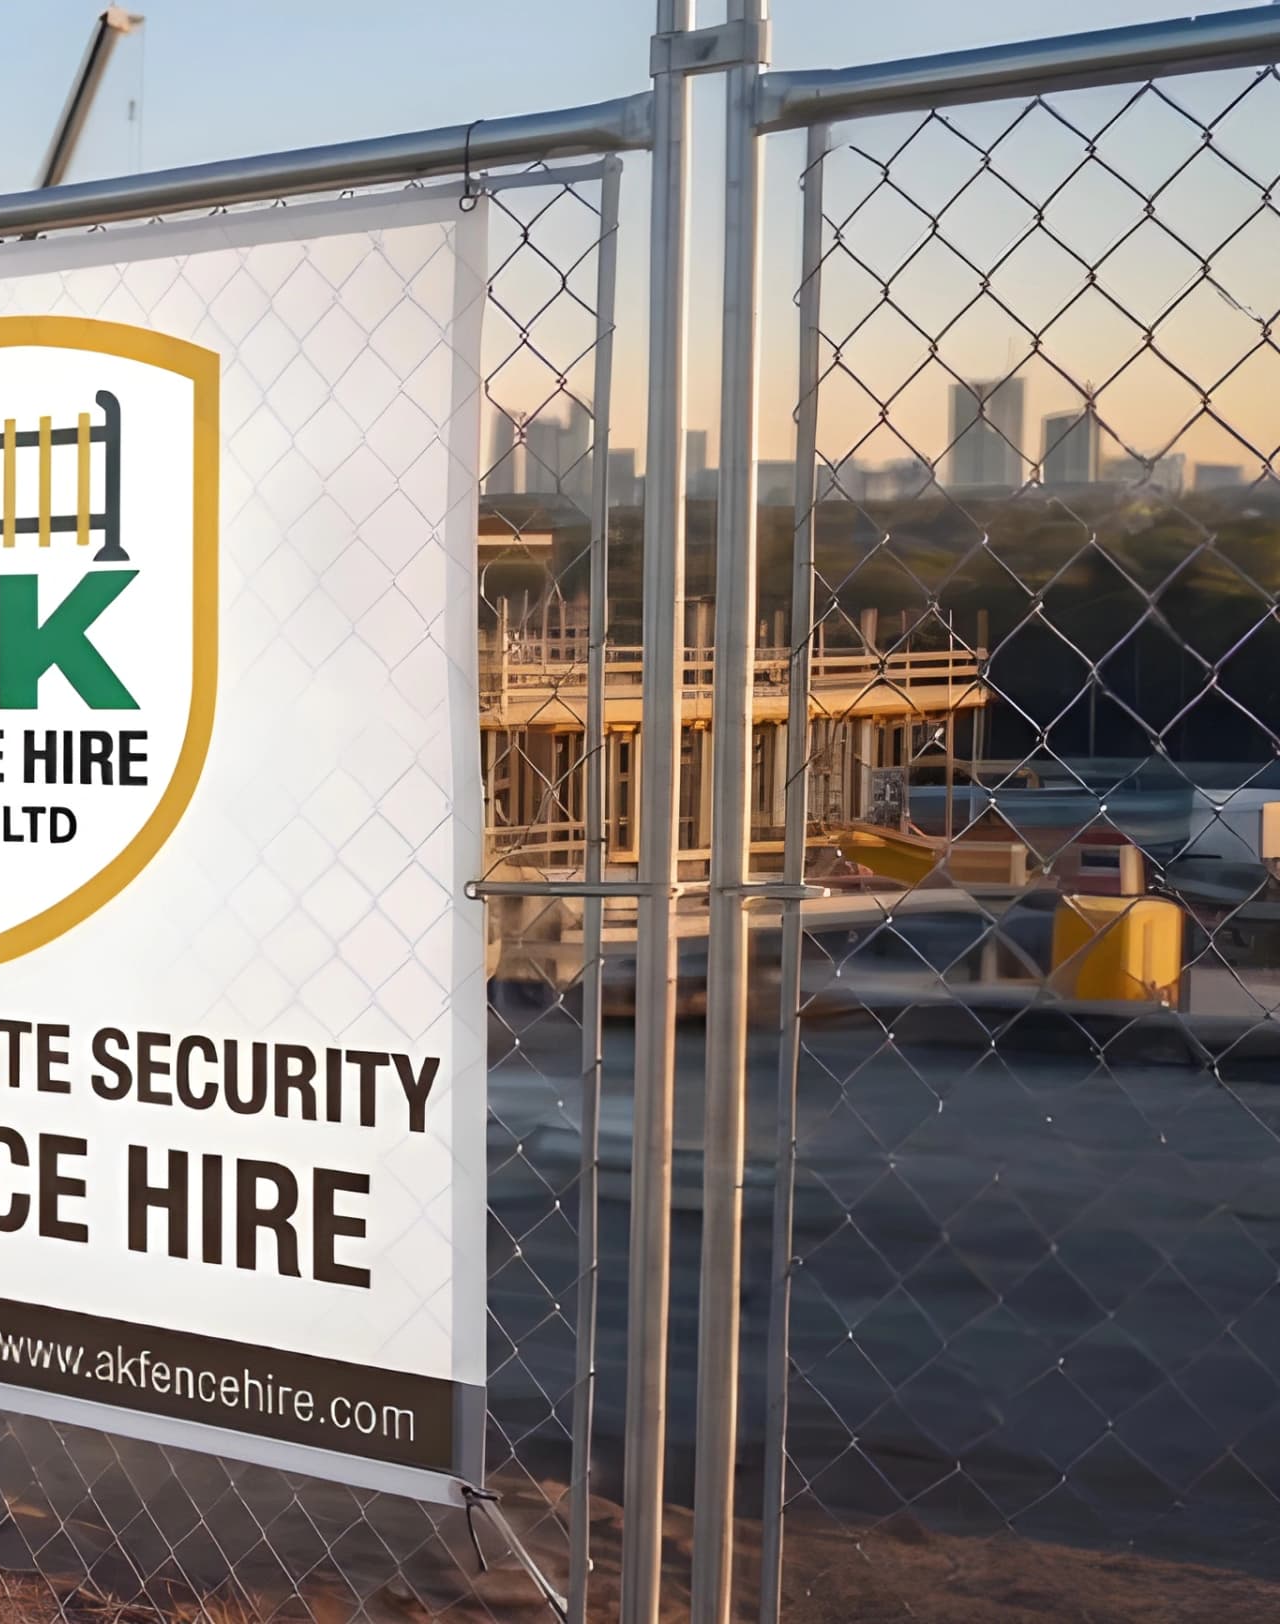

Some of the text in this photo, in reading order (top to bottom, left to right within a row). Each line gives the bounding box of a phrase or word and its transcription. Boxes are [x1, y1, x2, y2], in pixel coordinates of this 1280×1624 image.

[22, 728, 149, 787] HIRE
[2, 804, 78, 844] LTD
[90, 1026, 442, 1134] SECURITY
[126, 1143, 372, 1290] HIRE
